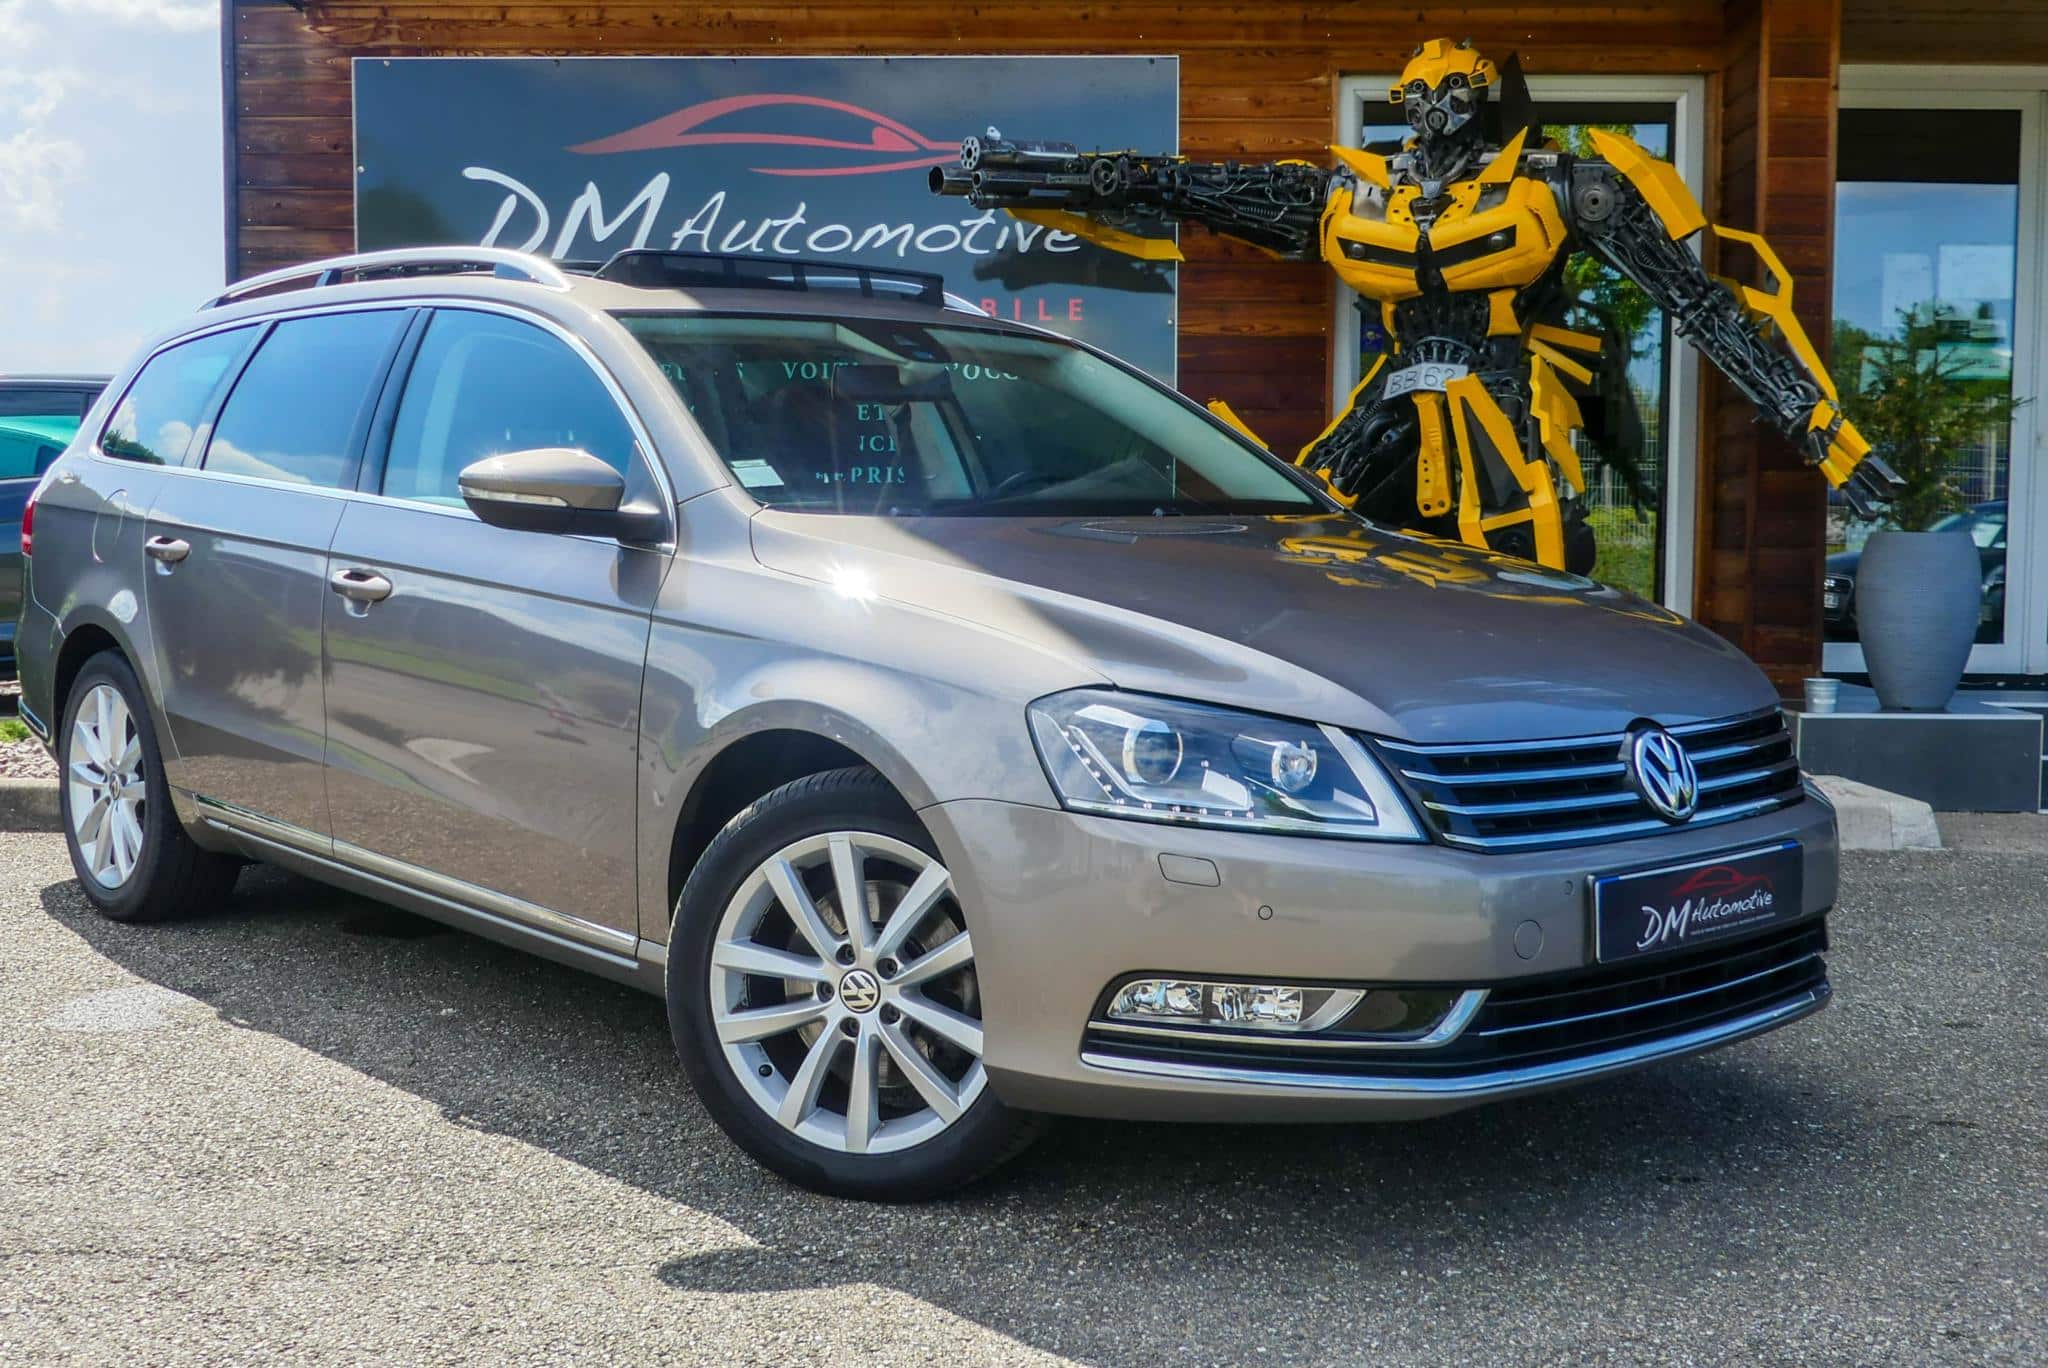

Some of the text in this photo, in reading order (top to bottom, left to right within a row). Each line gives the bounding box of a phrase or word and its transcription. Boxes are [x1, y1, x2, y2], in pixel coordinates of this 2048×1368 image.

[461, 166, 1081, 260] DM Automotive
[1636, 899, 1692, 949] DM
[1691, 888, 1774, 923] Automotive
